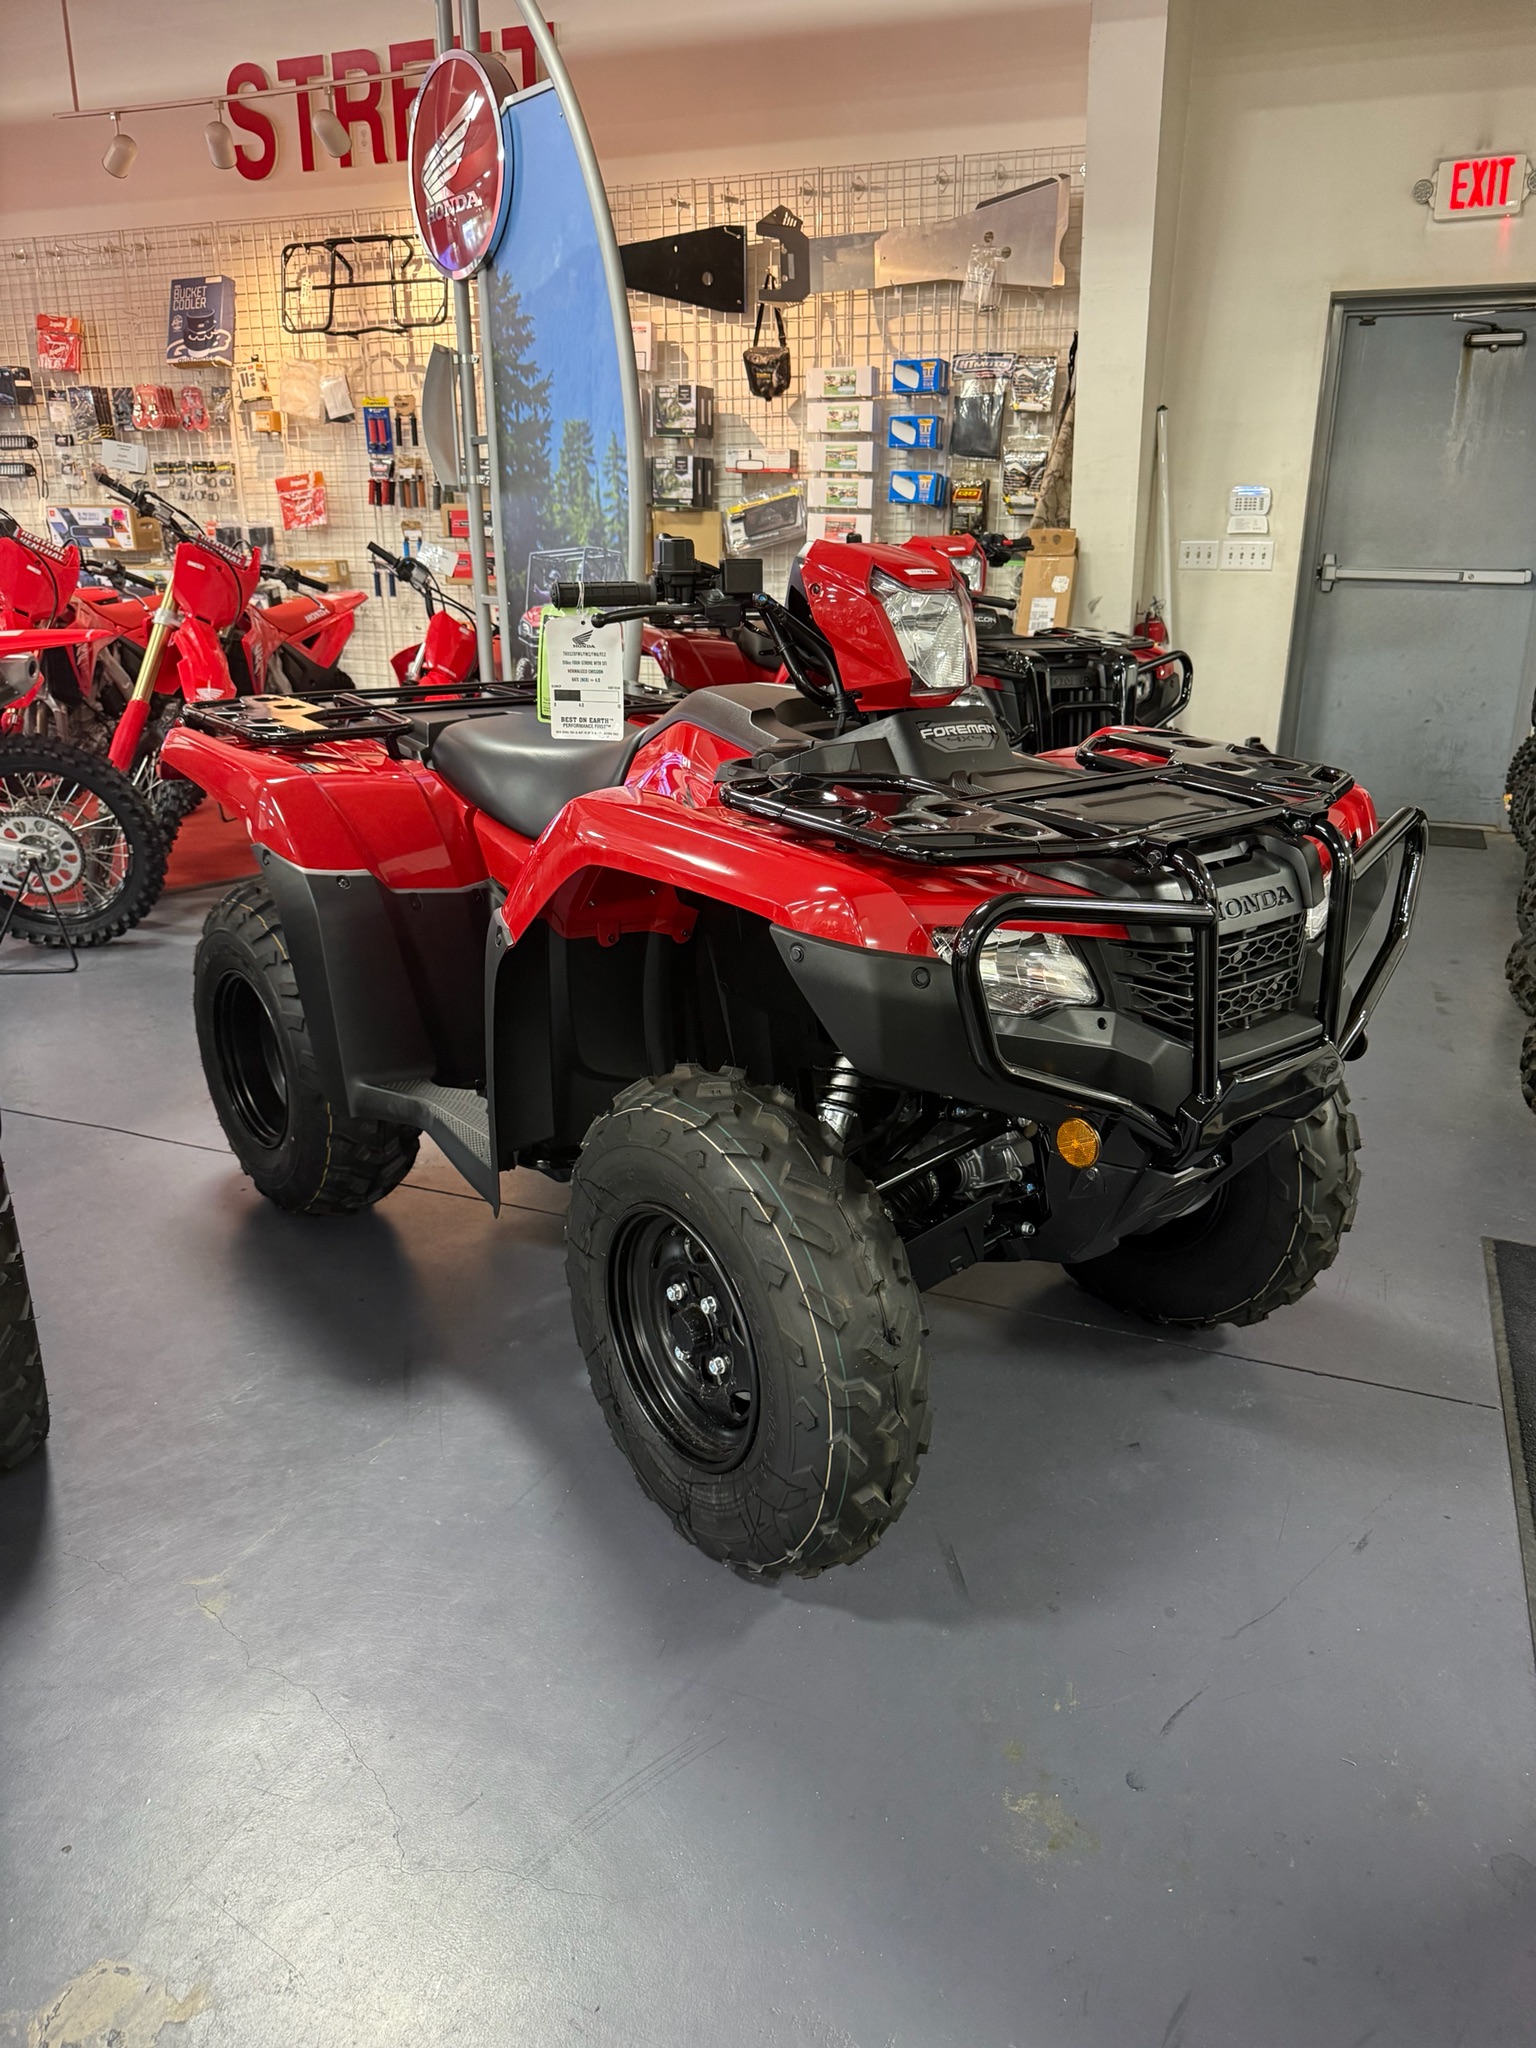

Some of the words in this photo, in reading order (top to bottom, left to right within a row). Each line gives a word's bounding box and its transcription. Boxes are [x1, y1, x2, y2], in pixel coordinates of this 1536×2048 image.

[227, 21, 556, 181] STRET
[1449, 156, 1516, 210] EXIT
[425, 189, 484, 225] HONDA
[173, 297, 207, 311] COOLER
[174, 285, 208, 300] BUCKET
[19, 536, 65, 562] RENTHAL
[20, 530, 68, 556] RENTHAL
[974, 615, 997, 624] ICON
[919, 723, 997, 739] FOREMAN
